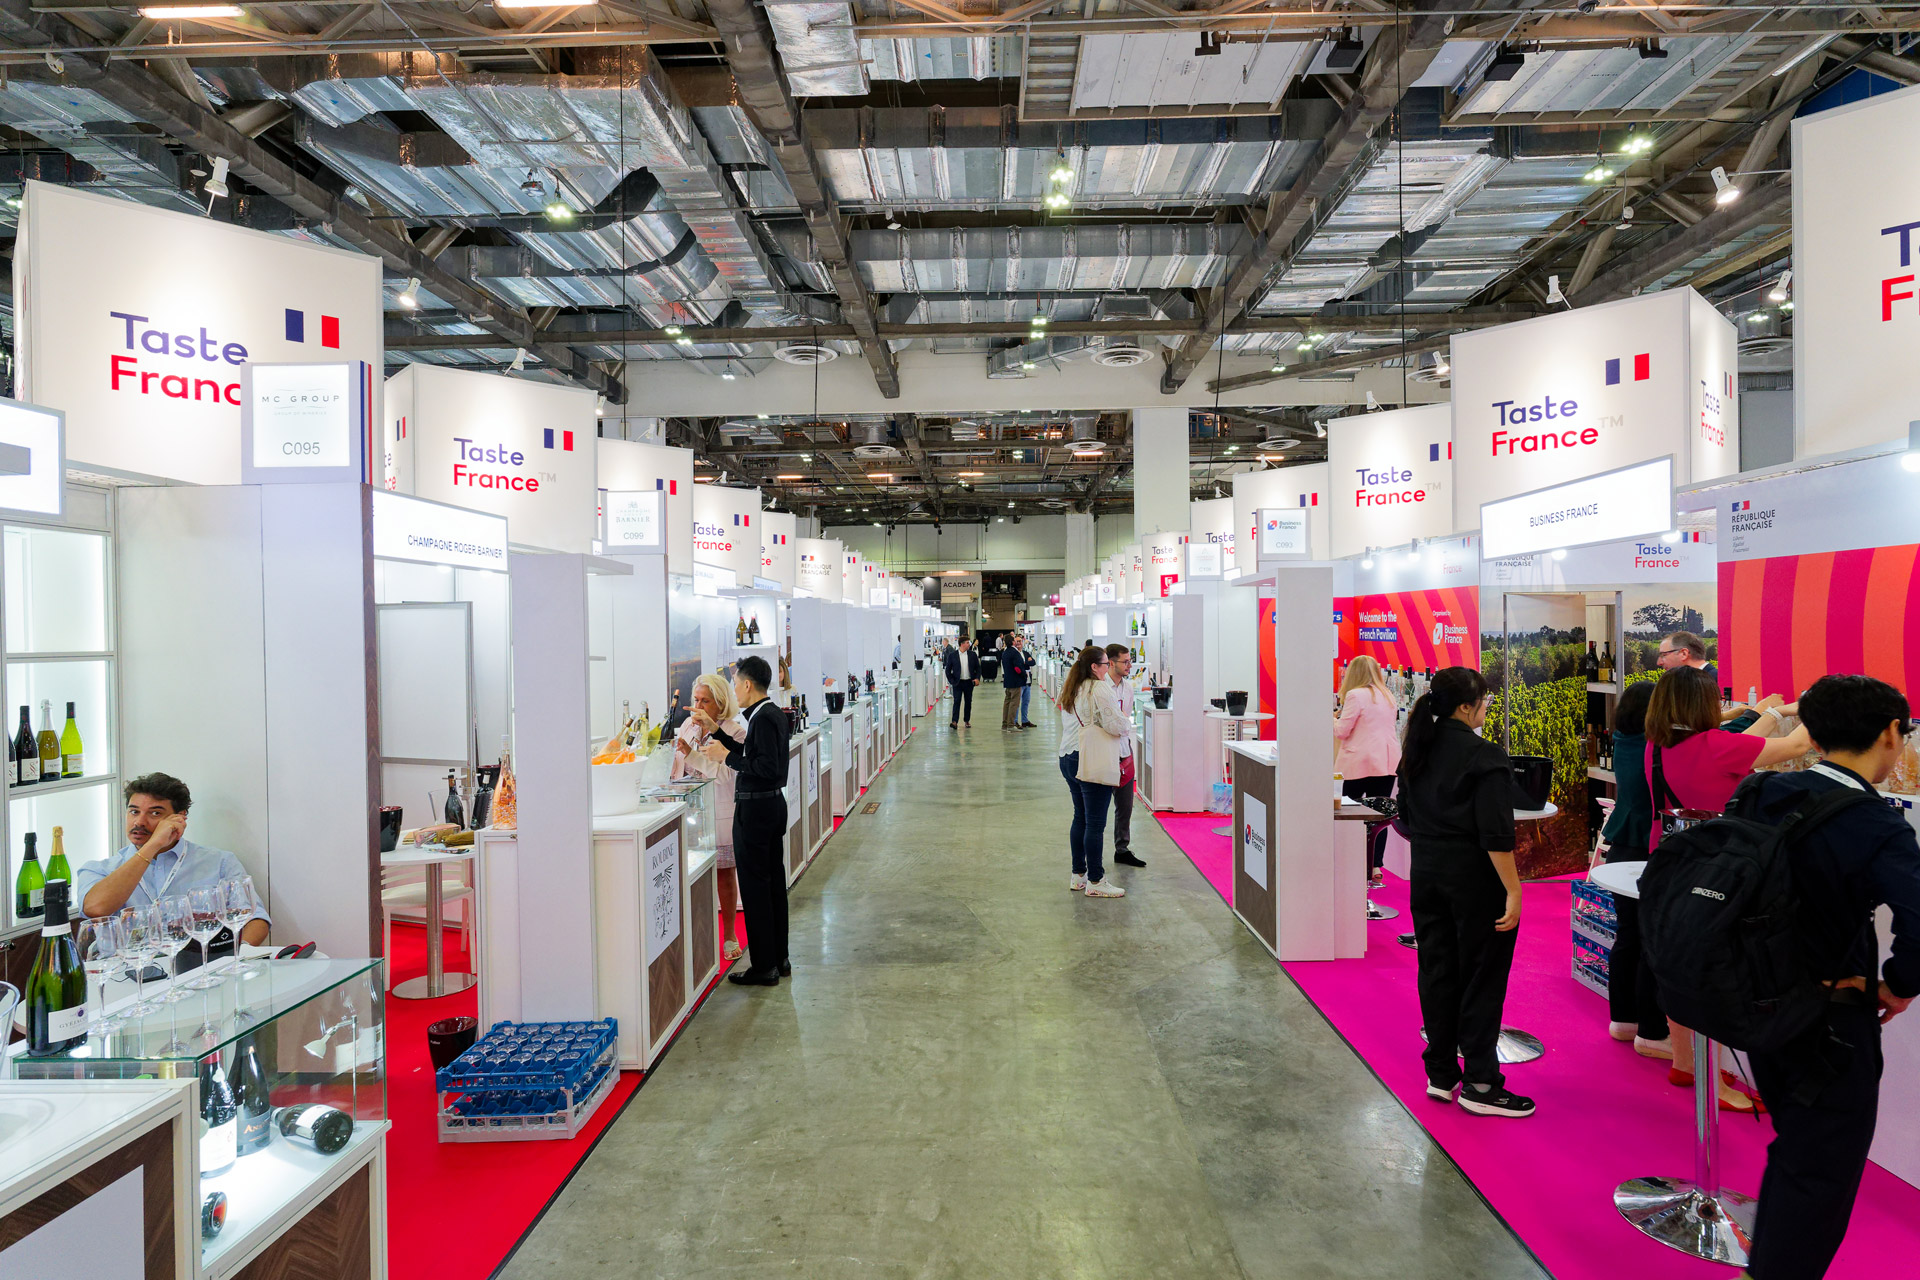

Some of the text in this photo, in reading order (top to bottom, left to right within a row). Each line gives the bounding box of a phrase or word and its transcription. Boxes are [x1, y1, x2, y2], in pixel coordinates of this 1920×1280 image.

[110, 311, 249, 365] Taste
[111, 354, 241, 406] Franc
[290, 395, 340, 403] GROUP
[1701, 379, 1720, 415] Taste
[1492, 395, 1578, 427] Taste
[1701, 411, 1724, 448] France
[282, 441, 321, 456] C095
[1492, 427, 1599, 457] France
[453, 437, 524, 466] Taste
[453, 463, 540, 492] France
[1356, 466, 1413, 486] Taste
[1356, 488, 1426, 507] France
[1530, 502, 1599, 528] BUSINESS FRANCE
[1731, 509, 1776, 523] RÉPUBLIQUE
[693, 522, 725, 537] Taste
[1731, 520, 1773, 533] FRANÇAISE
[623, 532, 645, 540] C099
[1205, 531, 1234, 543] Taste
[408, 535, 503, 559] CHAMPAGNE ROGER BARNIER
[1152, 546, 1173, 555] Taste
[1275, 541, 1293, 549] C093
[1634, 543, 1672, 555] Taste
[1151, 555, 1178, 564] France
[1495, 560, 1532, 568] FRANÇAISE
[1634, 555, 1680, 568] France
[1359, 610, 1397, 622] Welcome to the
[1359, 628, 1397, 641] French Pavilion
[1444, 624, 1468, 635] Business
[1444, 635, 1463, 644] France
